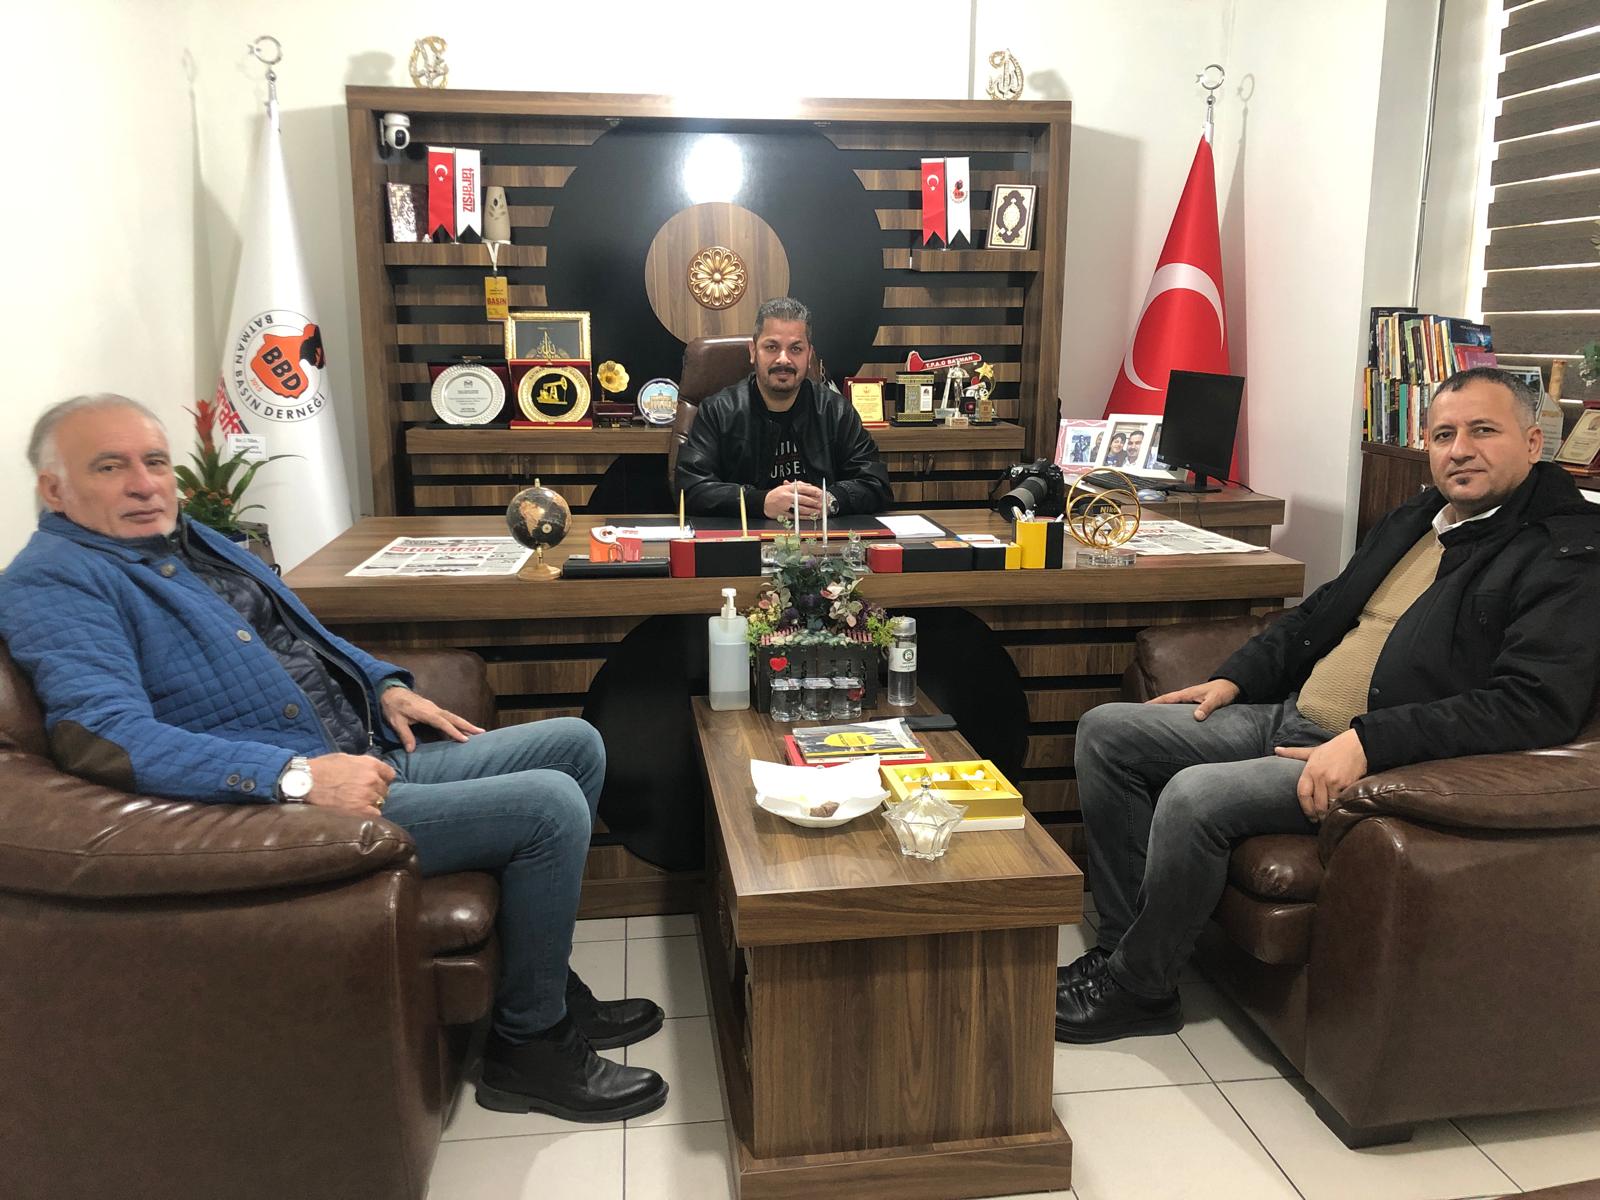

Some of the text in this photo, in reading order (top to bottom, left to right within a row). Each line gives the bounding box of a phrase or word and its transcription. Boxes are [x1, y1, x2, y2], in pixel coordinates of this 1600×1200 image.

[234, 314, 274, 364] BATMAN
[234, 370, 261, 410] BASIN
[261, 346, 301, 391] BBD
